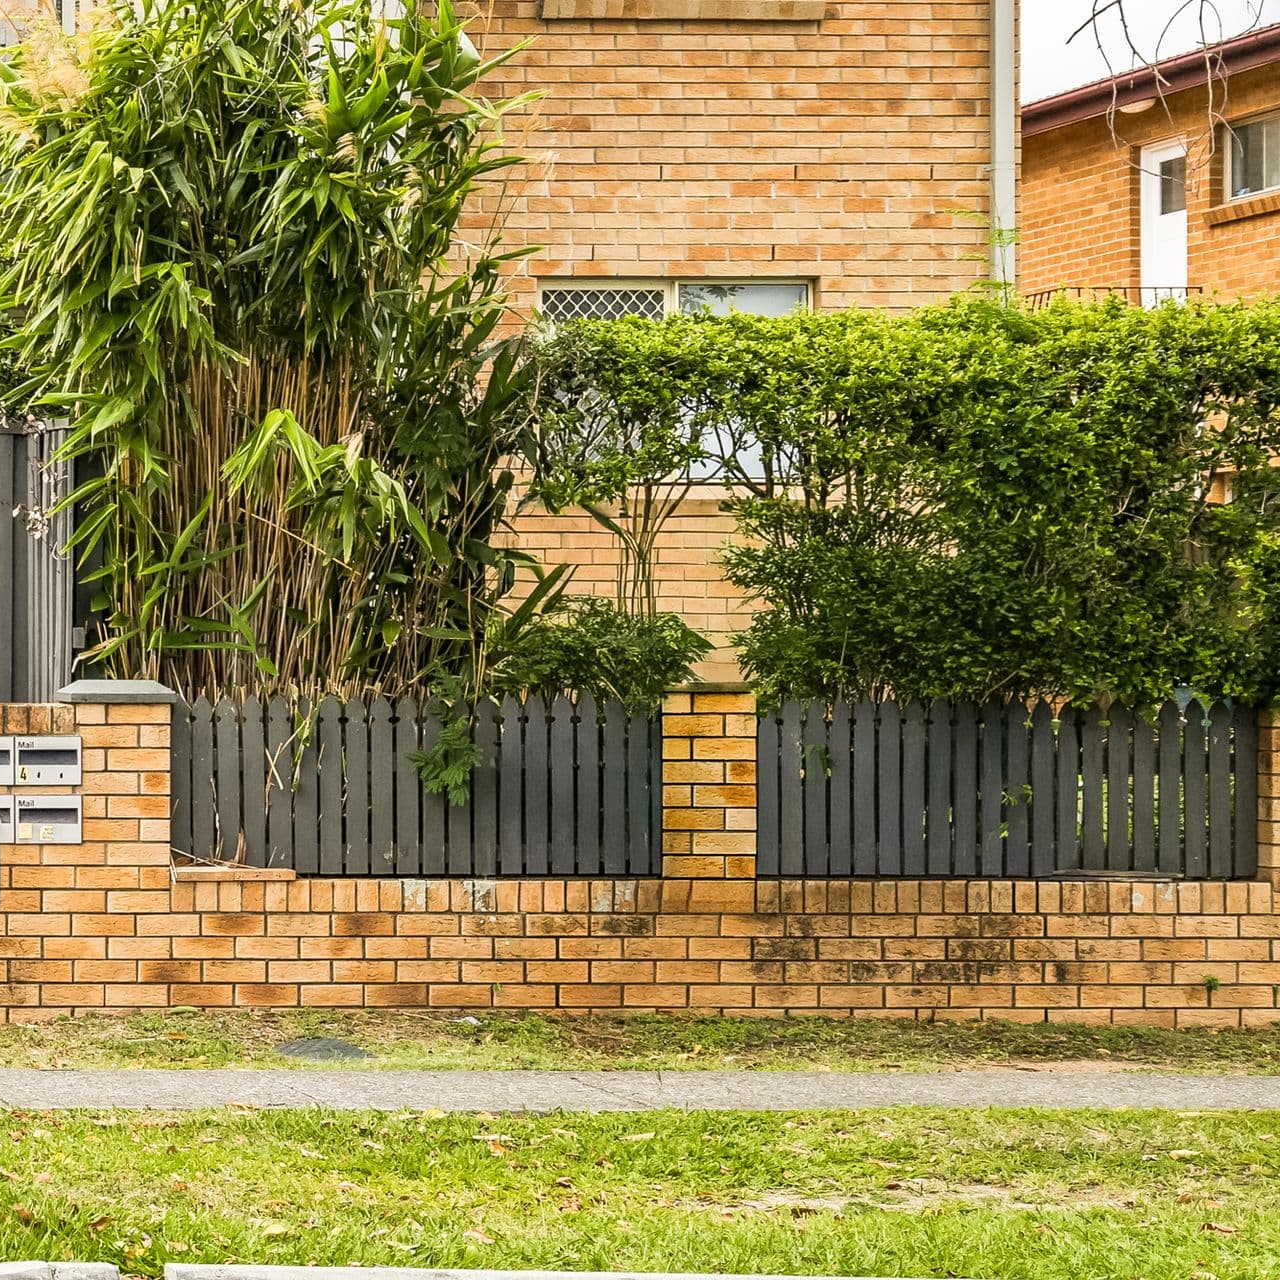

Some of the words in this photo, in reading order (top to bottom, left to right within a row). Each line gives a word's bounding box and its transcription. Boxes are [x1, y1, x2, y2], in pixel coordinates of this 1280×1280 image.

[18, 741, 35, 749] Mail
[20, 767, 27, 781] 4
[18, 799, 35, 807] Mail
